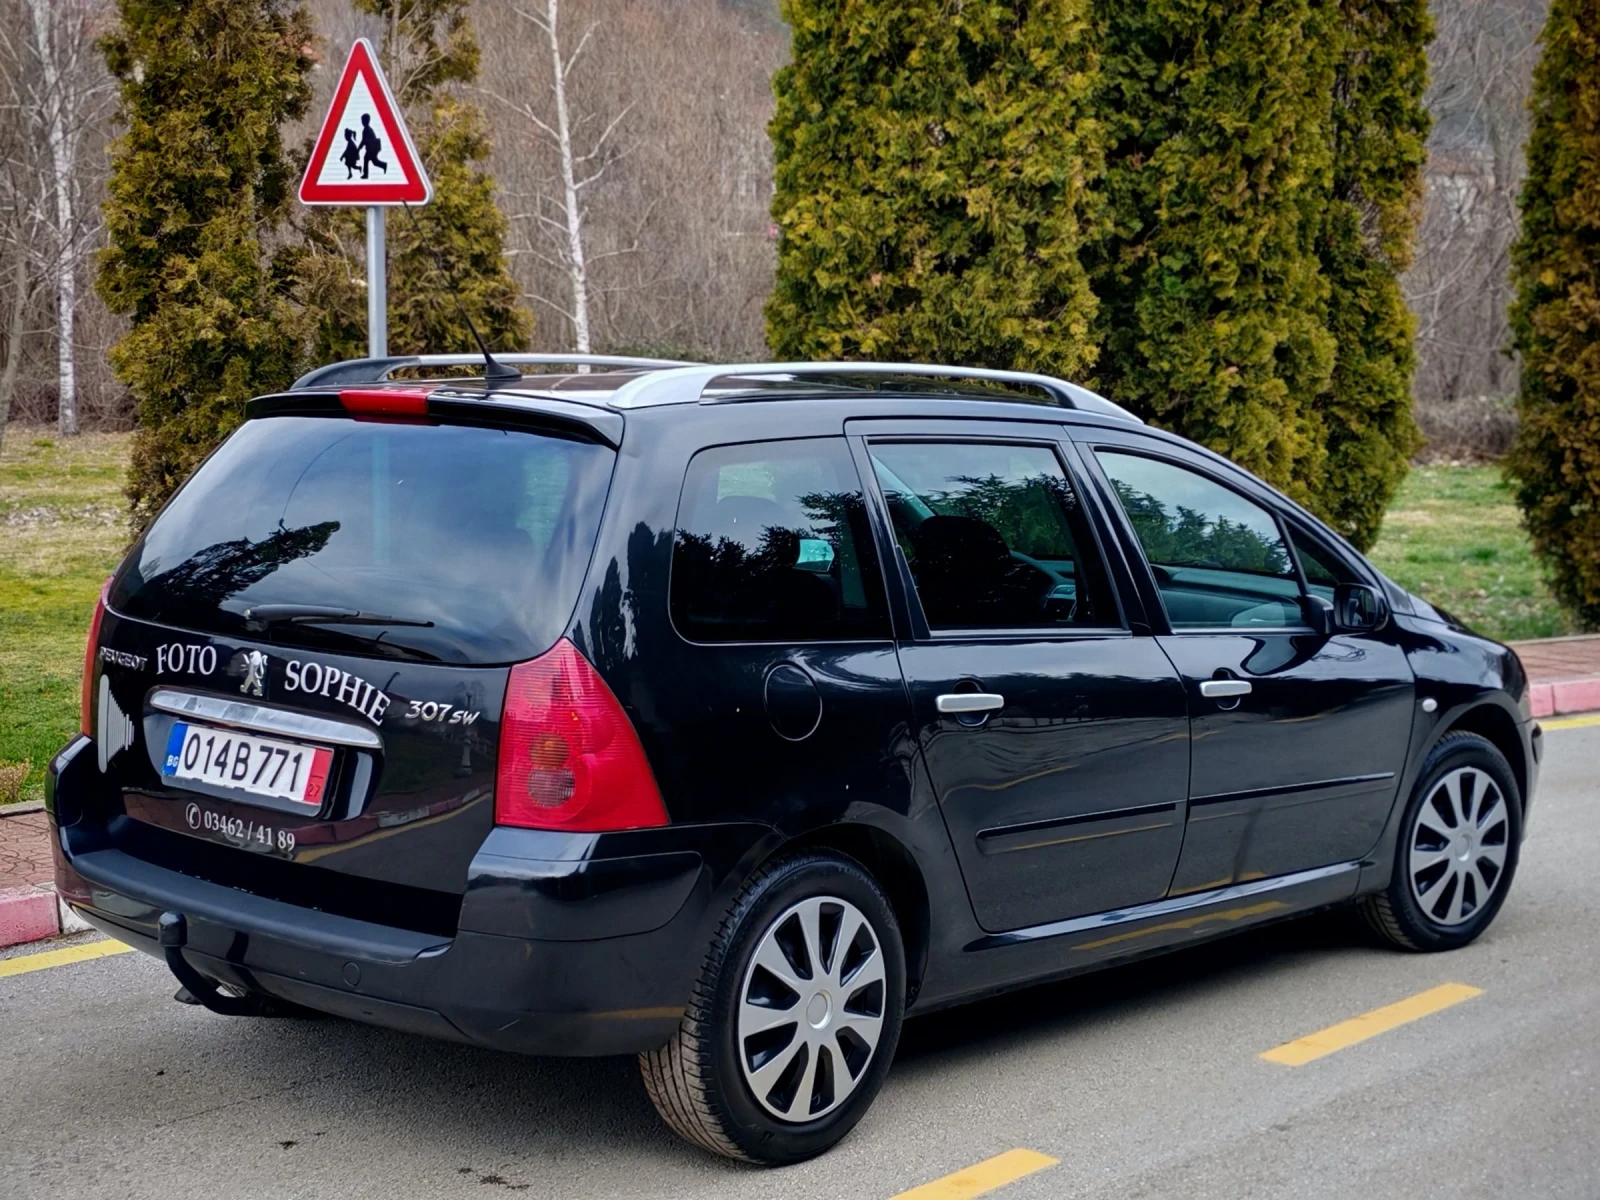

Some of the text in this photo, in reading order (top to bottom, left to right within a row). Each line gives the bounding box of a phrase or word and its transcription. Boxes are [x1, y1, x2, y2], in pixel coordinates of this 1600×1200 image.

[99, 646, 148, 671] PEUGEOT
[156, 643, 391, 726] FOTO SOPHIE
[404, 700, 480, 725] 307 SW
[166, 755, 179, 767] BG
[184, 733, 303, 792] 014B771
[204, 811, 244, 838] 03462
[256, 825, 273, 846] 41
[277, 830, 295, 851] 89
